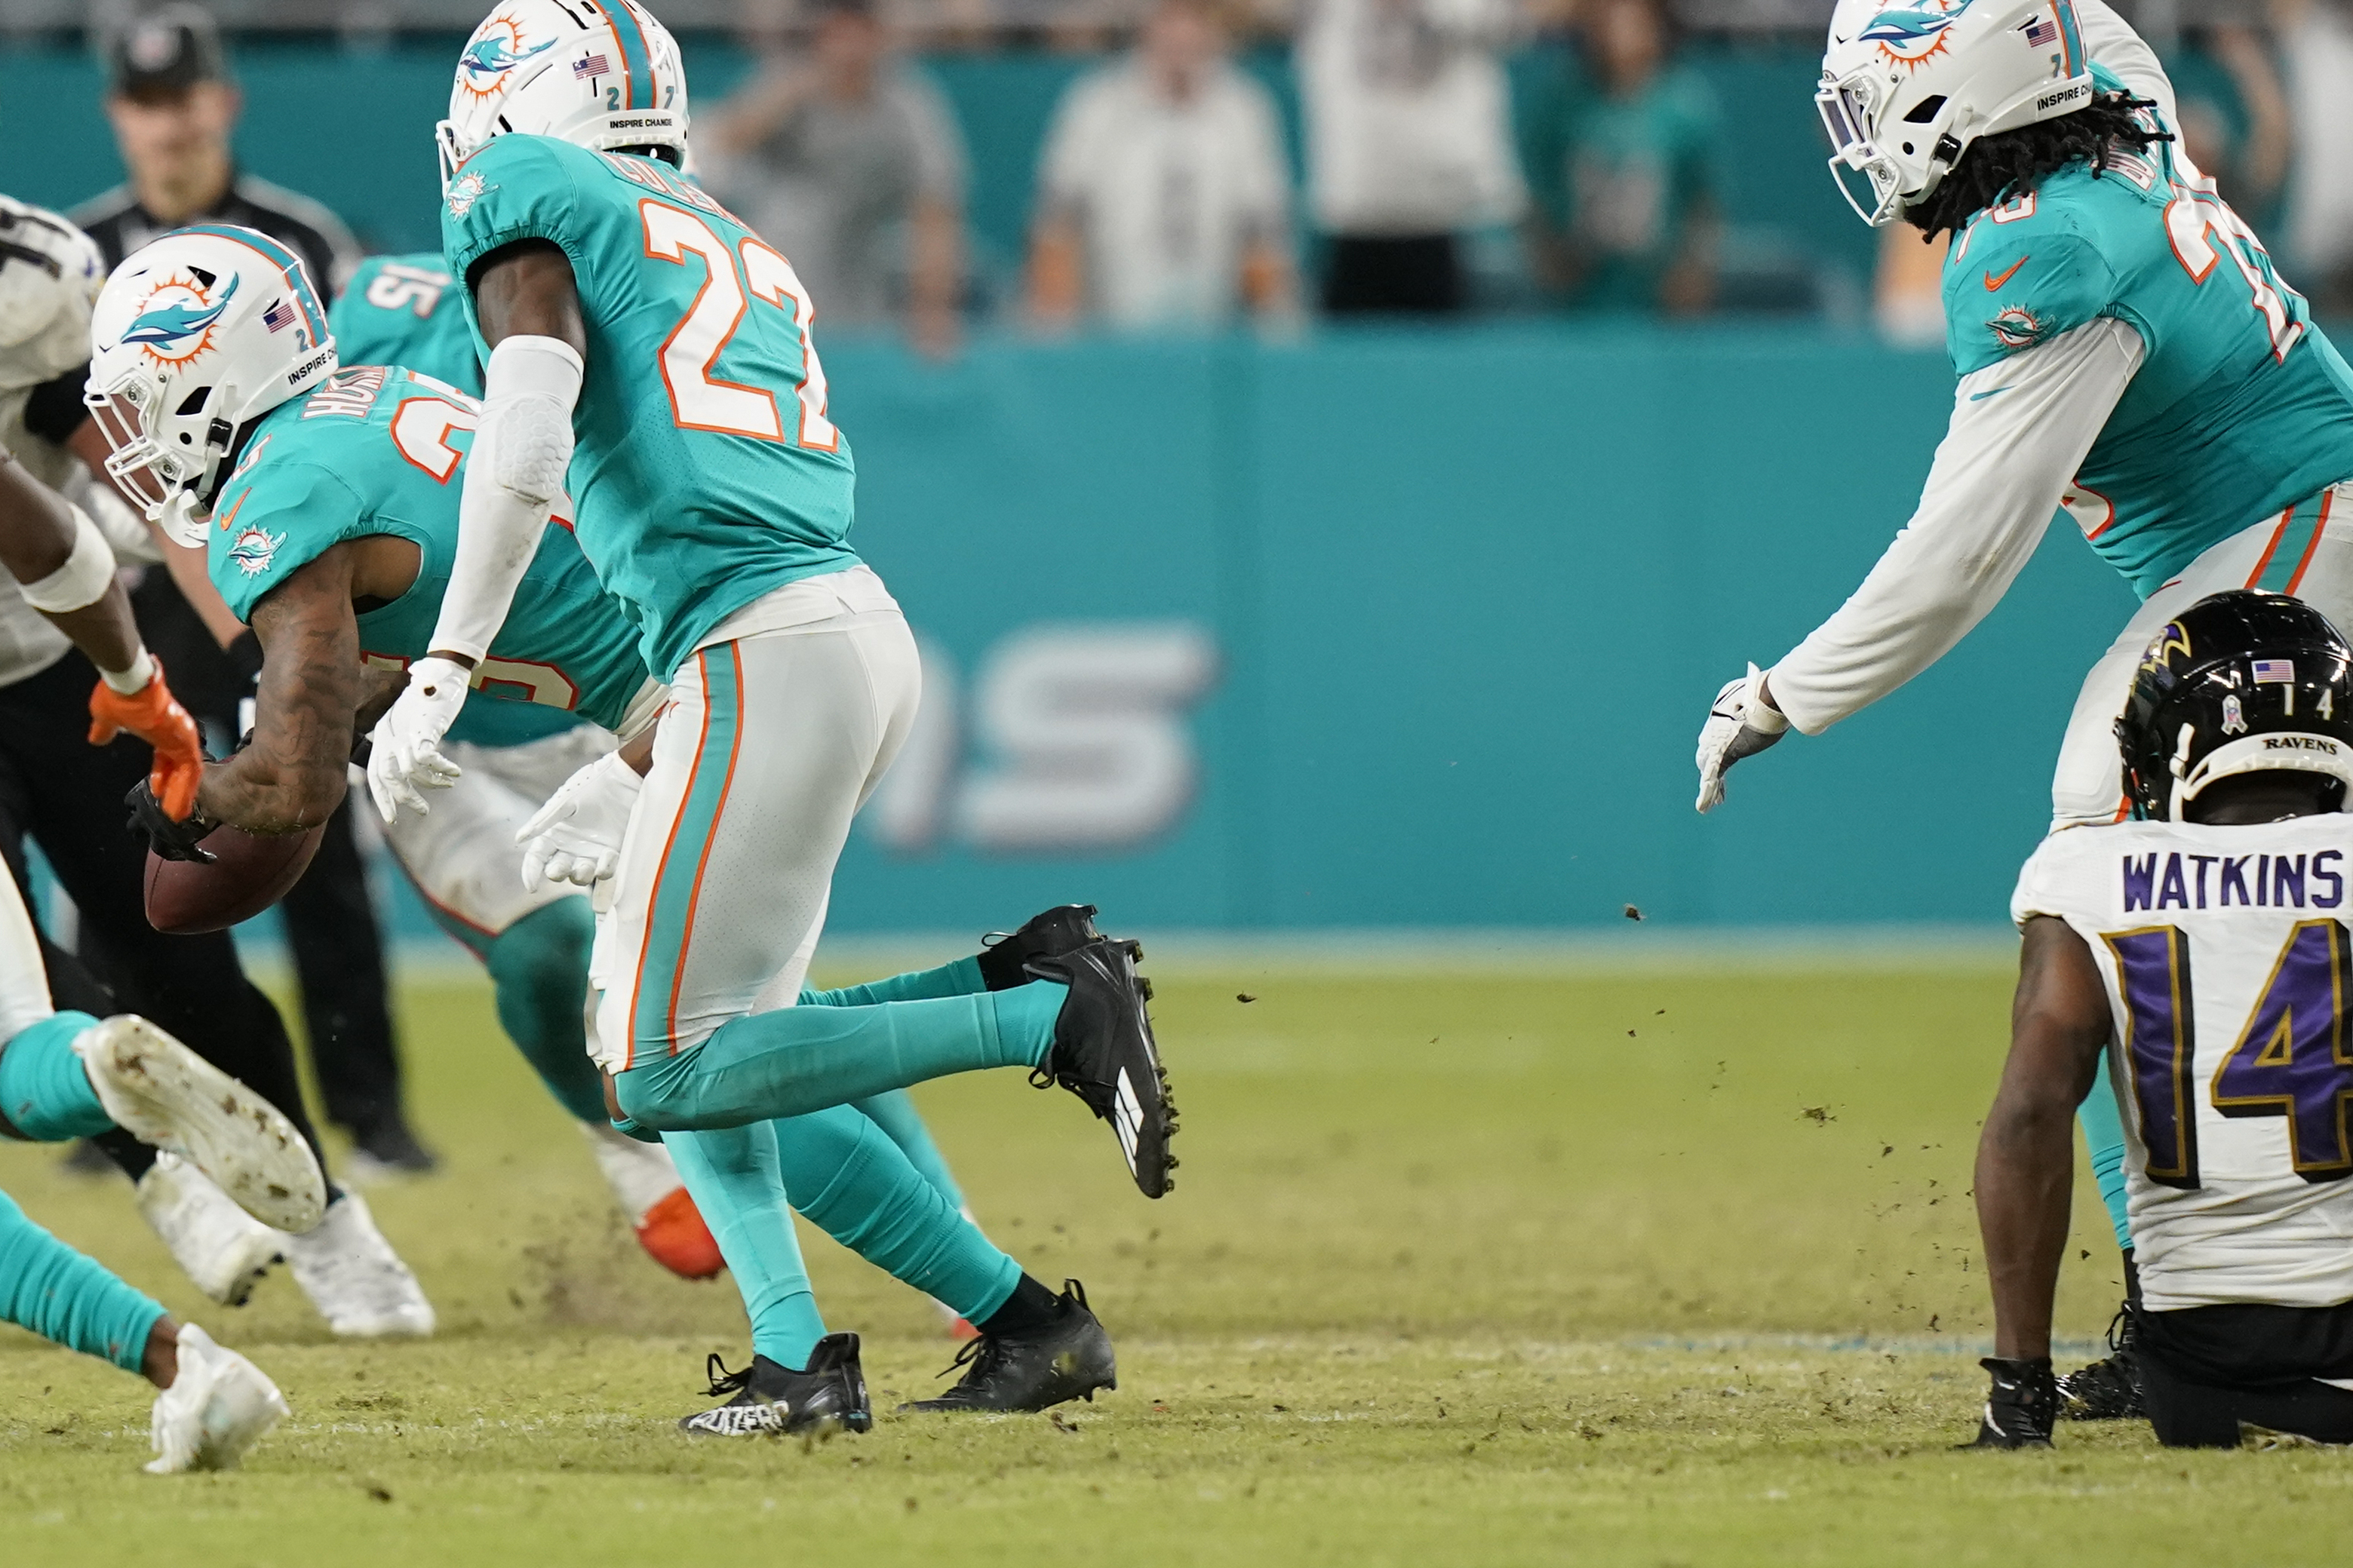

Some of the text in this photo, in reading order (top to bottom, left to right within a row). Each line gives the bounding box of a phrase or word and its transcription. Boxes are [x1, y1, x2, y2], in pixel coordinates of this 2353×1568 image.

[607, 85, 674, 111] 2 7
[2037, 87, 2079, 111] INSPIRE
[610, 118, 673, 129] INSPIRE CHANGE
[637, 197, 838, 453] 27
[287, 352, 327, 385] INSPIRE
[2262, 737, 2338, 756] RAVENS
[2122, 849, 2344, 913] WATKINS
[2098, 917, 2353, 1190] 14
